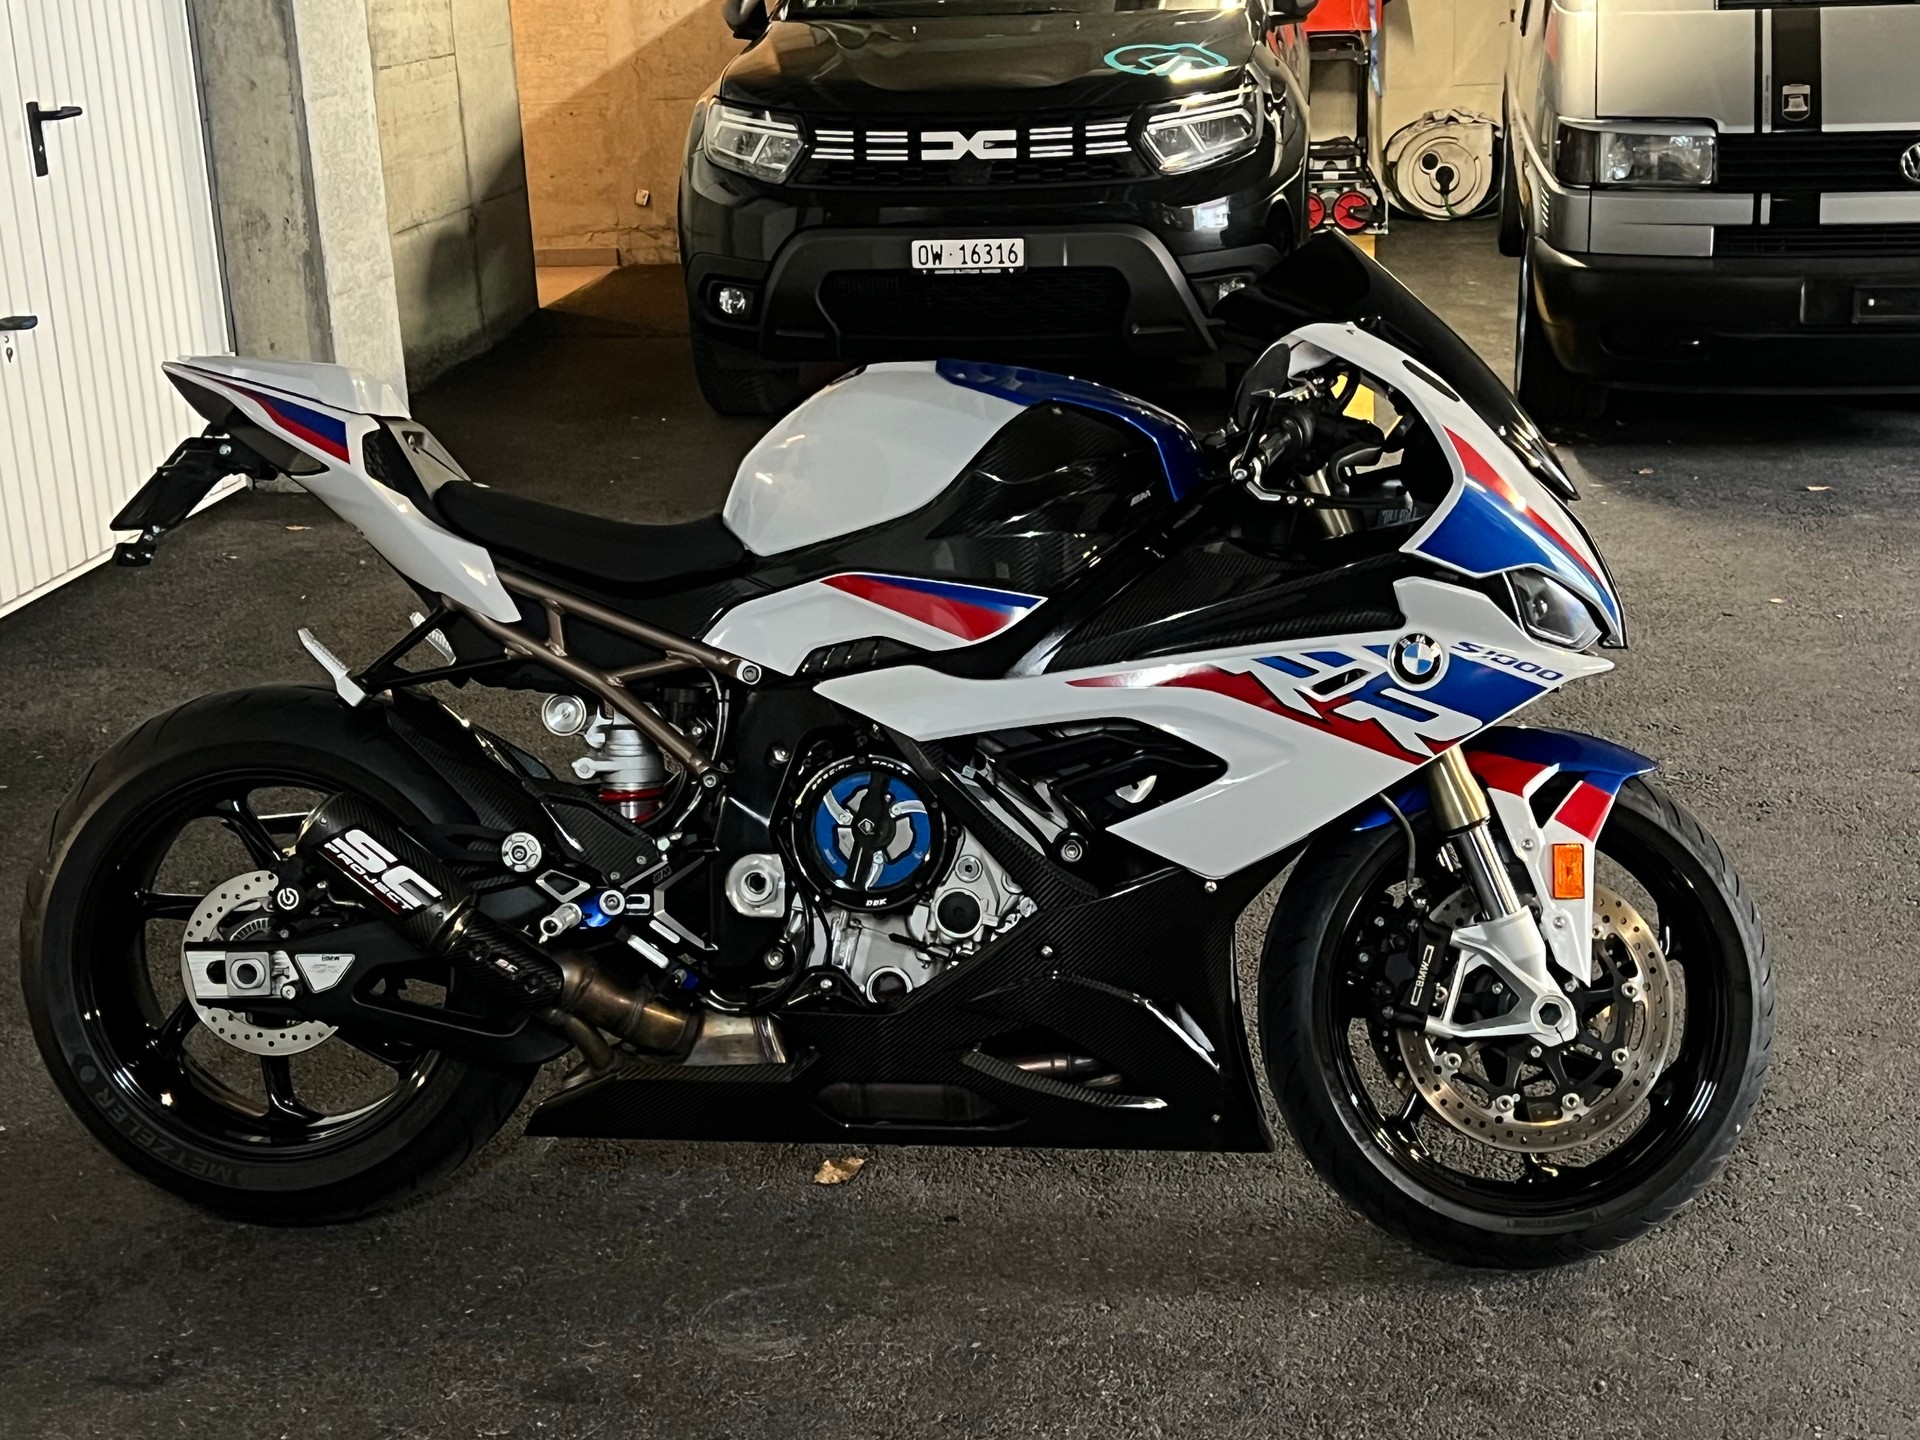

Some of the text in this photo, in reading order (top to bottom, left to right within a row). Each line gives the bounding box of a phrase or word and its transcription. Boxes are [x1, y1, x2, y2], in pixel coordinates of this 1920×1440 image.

[917, 242, 1019, 266] OW 16316
[1451, 641, 1565, 681] S1000
[323, 842, 414, 911] PROJECT
[1415, 960, 1430, 988] BMW
[94, 1087, 235, 1183] METZELER
